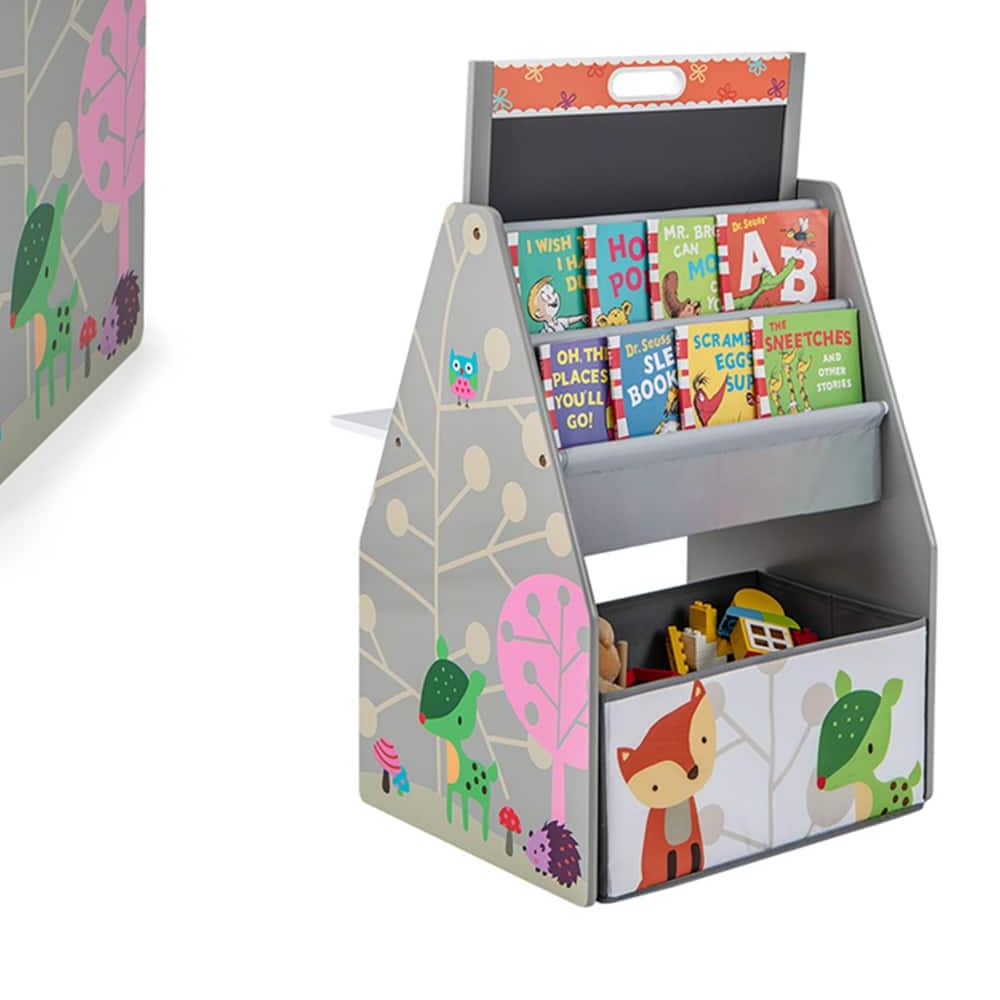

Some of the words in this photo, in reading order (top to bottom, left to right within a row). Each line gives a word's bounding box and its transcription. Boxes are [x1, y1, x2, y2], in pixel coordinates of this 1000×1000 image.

[663, 224, 689, 241] MR.
[731, 220, 742, 232] Dr.
[535, 234, 572, 254] WISH
[608, 233, 646, 263] HO
[673, 243, 699, 258] CAN
[687, 253, 719, 280] MO
[608, 266, 650, 298] PO
[769, 320, 787, 331] THE
[624, 343, 641, 358] Dr.
[765, 329, 852, 353] SNEETCHES
[643, 346, 675, 374] SLE
[714, 351, 754, 371] EGGS
[823, 352, 842, 362] AND
[552, 368, 608, 388] PLACES
[817, 366, 847, 377] OTHER
[627, 370, 677, 407] BOOK
[816, 379, 852, 392] STORIES
[555, 389, 605, 409] YOU'LL
[567, 411, 593, 429] GO!
